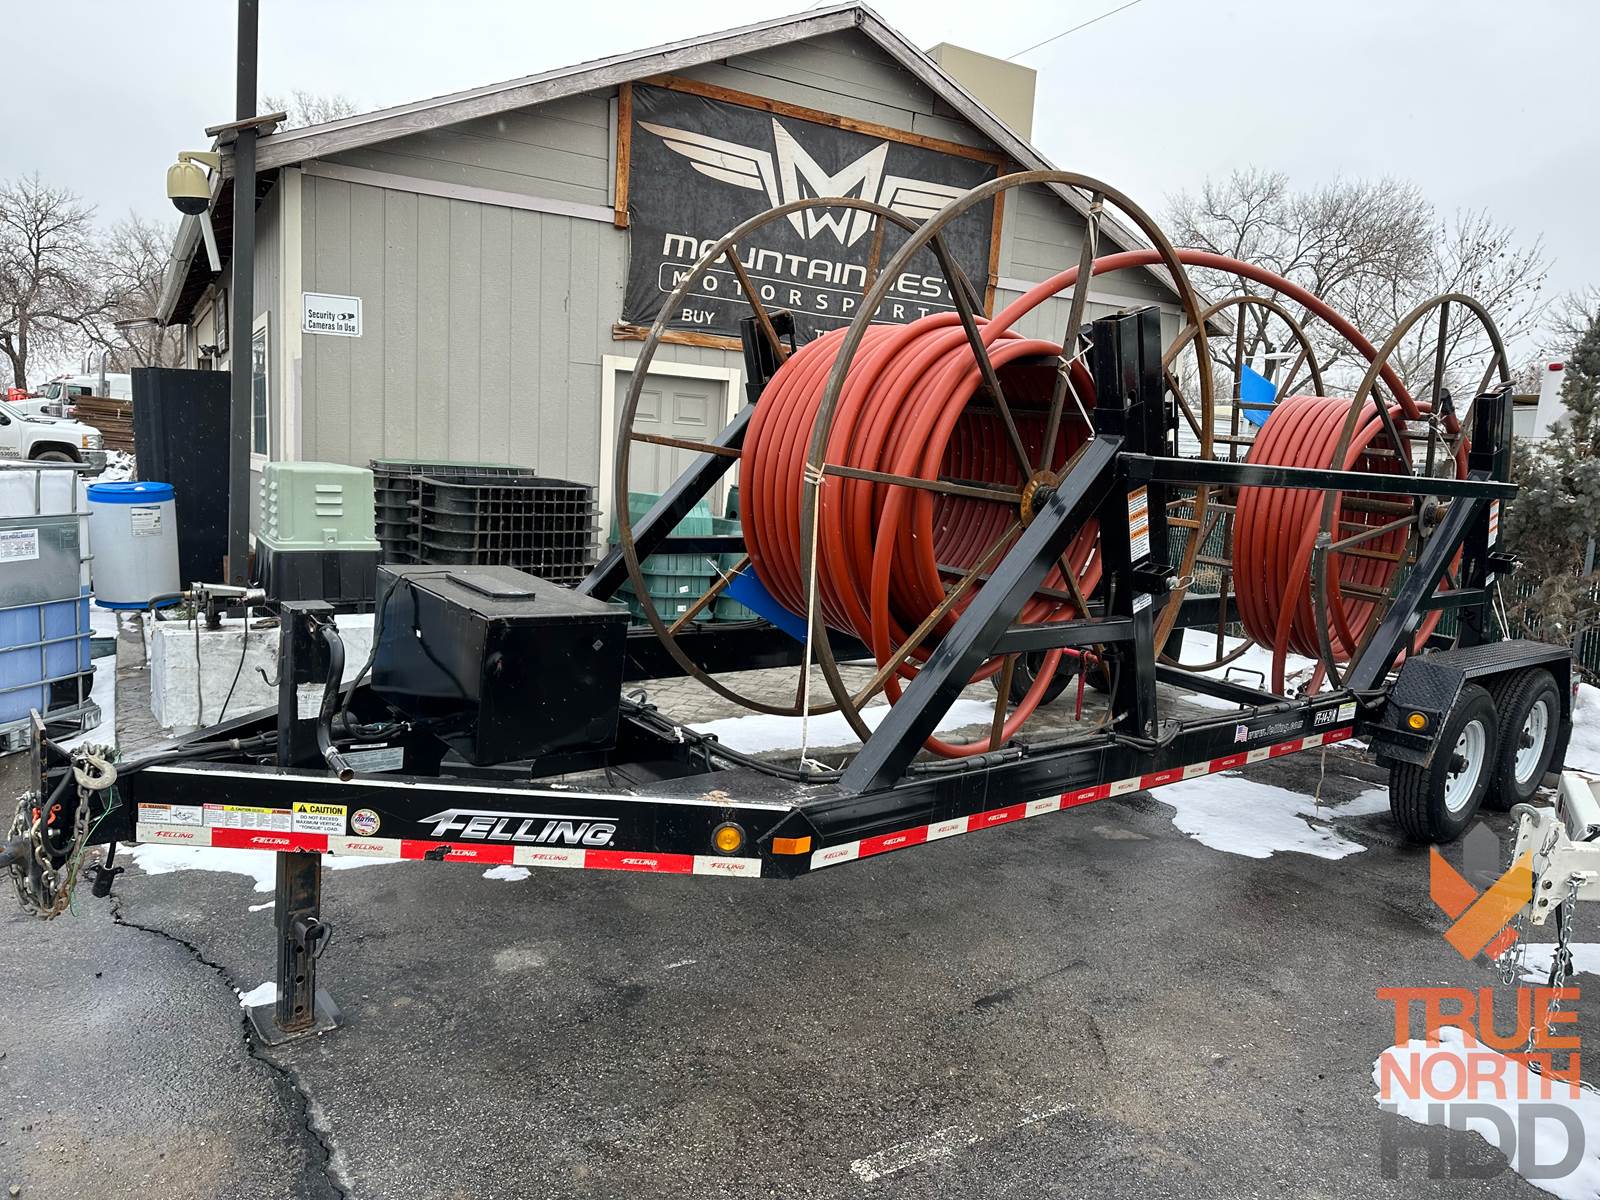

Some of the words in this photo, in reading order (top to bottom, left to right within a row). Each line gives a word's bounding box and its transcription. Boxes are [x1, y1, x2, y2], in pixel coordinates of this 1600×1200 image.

[672, 270, 930, 320] MOTORSPRT
[308, 309, 335, 322] Security
[682, 308, 715, 325] BUY
[308, 319, 335, 331] Cameras
[336, 322, 343, 331] In
[344, 323, 356, 332] Use
[310, 805, 343, 815] CAUTION
[416, 808, 620, 847] FELLING
[938, 823, 959, 833] FELLING
[154, 830, 194, 839] FELLING
[250, 836, 290, 845] FELLING
[883, 835, 906, 846] FELLING
[345, 842, 384, 851] FELLING
[450, 848, 478, 857] ELLING
[531, 852, 569, 862] FELLING
[823, 850, 849, 860] FELLING
[621, 857, 658, 867] FELLING
[709, 862, 745, 870] FELLING
